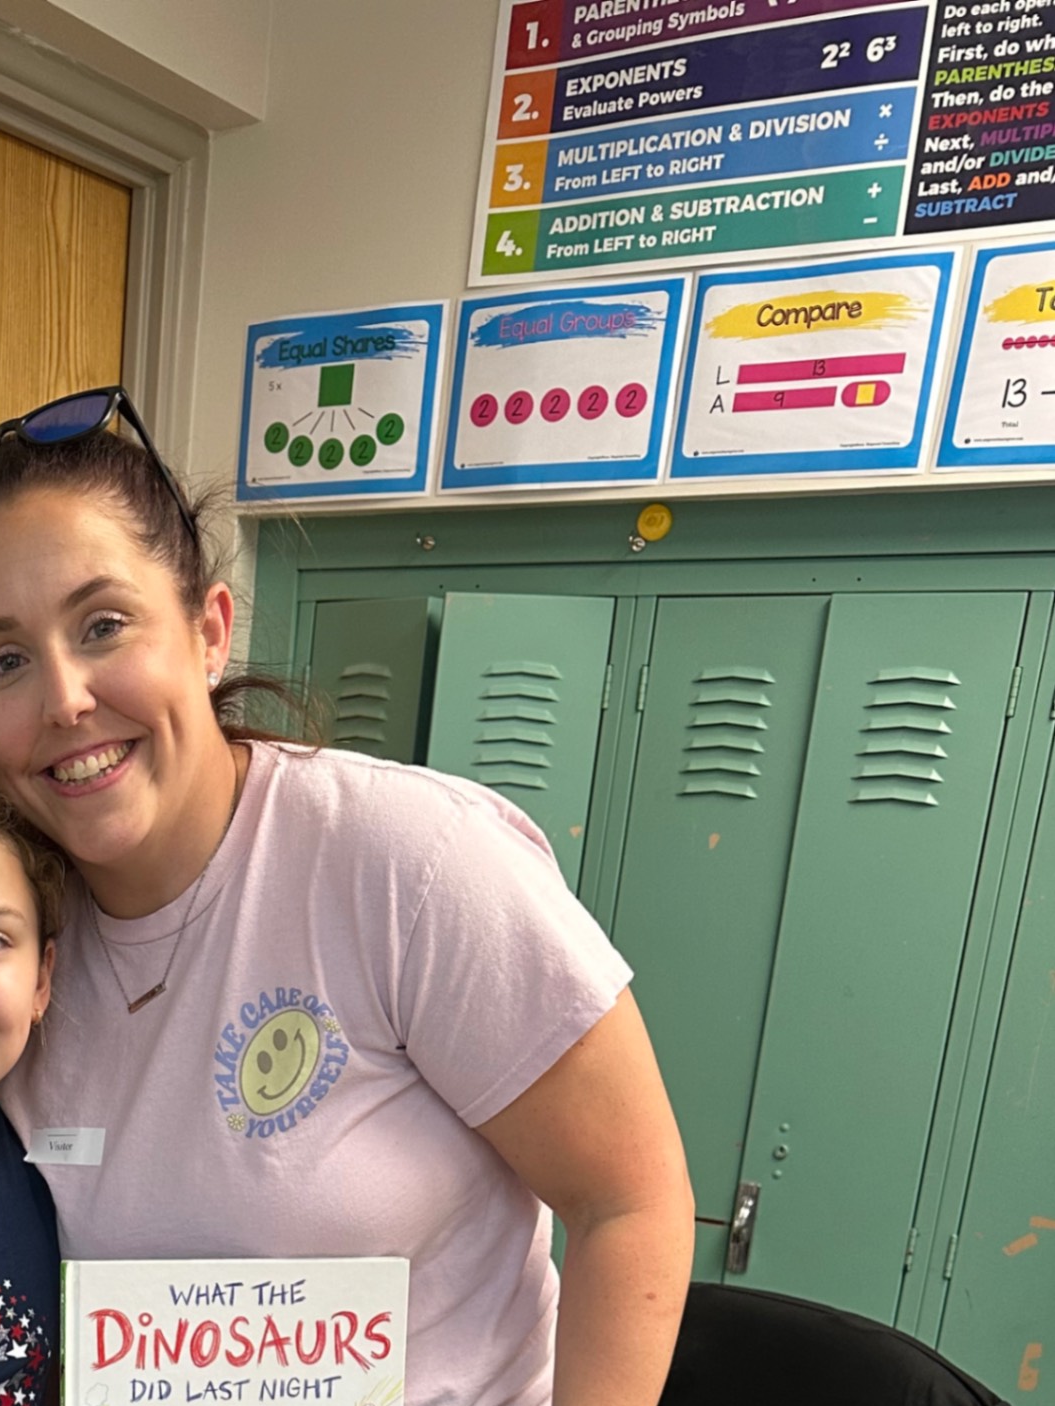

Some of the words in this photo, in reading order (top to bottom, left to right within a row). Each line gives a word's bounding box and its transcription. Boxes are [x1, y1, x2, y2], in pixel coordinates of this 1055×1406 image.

[944, 5, 967, 19] Do
[971, 0, 1011, 15] each
[526, 22, 549, 49] 1.
[571, 34, 582, 48] &
[586, 18, 663, 44] Grouping
[667, 1, 745, 30] Symbols
[941, 22, 971, 38] left
[975, 21, 993, 34] to
[997, 14, 1043, 33] right.
[937, 44, 988, 63] First,
[993, 39, 1020, 57] do
[565, 58, 687, 97] EXPONENTS
[512, 94, 539, 121] 2.
[562, 95, 634, 121] Evaluate
[638, 84, 703, 108] Powers
[931, 90, 984, 108] Then,
[989, 84, 1015, 102] do
[1020, 80, 1054, 98] the
[928, 101, 1050, 131] EXPONENTS
[557, 126, 723, 167] MULTIPLICATION
[728, 123, 742, 141] &
[748, 109, 851, 139] DIVISION
[924, 134, 975, 153] Next,
[554, 174, 597, 191] From
[601, 165, 642, 184] LEFT
[646, 162, 664, 178] to
[669, 154, 725, 175] RIGHT
[920, 153, 985, 175] and/or
[989, 144, 1055, 167] DIVIDE
[503, 164, 531, 191] 3.
[917, 179, 962, 197] Last,
[967, 172, 1011, 191] ADD
[549, 204, 645, 235] ADDITION
[651, 205, 664, 222] &
[669, 186, 825, 220] SUBTRACTION
[915, 192, 1018, 218] SUBTRACT
[496, 230, 523, 256] 4.
[546, 241, 589, 259] From
[593, 235, 635, 253] LEFT
[639, 232, 657, 248] to
[661, 225, 717, 246] RIGHT
[499, 313, 553, 341] Equal
[559, 311, 636, 334] Groups
[756, 298, 863, 329] Compare
[278, 336, 327, 364] Equal
[332, 334, 396, 356] Shares
[715, 365, 730, 385] L
[478, 399, 490, 418] 2
[511, 397, 523, 417] 2
[549, 395, 561, 414] 2
[587, 392, 599, 412] 2
[625, 389, 637, 410] 2
[709, 394, 725, 414] A
[773, 391, 785, 407] 9
[1002, 378, 1027, 408] 13
[272, 427, 282, 445] 2
[384, 420, 396, 438] 2
[294, 441, 304, 459] 2
[326, 445, 336, 462] 2
[358, 441, 368, 459] 2
[214, 1023, 245, 1112] TAKE
[240, 987, 302, 1029] CARE
[303, 995, 335, 1018] OF
[245, 1032, 350, 1138] YOURSELF
[169, 1282, 243, 1306] WHAT
[251, 1279, 307, 1305] THE
[130, 1379, 172, 1402] DID
[186, 1378, 250, 1402] LAST
[259, 1376, 342, 1400] NIGHT
